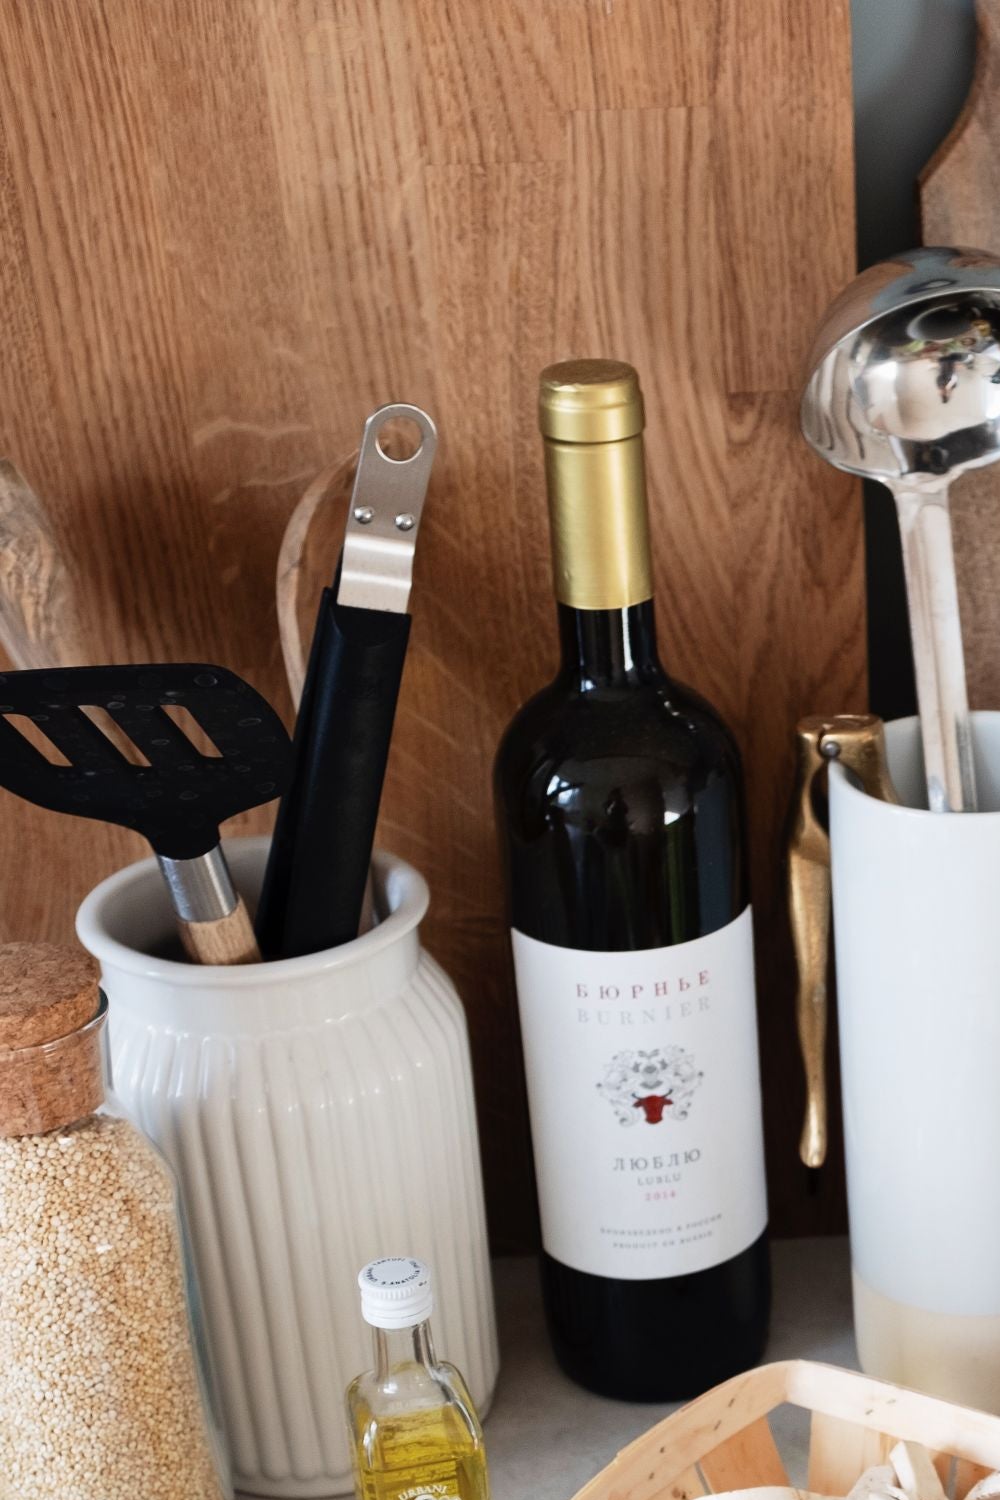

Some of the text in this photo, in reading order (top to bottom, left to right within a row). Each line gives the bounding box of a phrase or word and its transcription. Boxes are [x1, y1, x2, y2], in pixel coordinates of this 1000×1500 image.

[575, 969, 711, 1000] БЮРНЬЕ
[577, 996, 712, 1026] BURNIER
[613, 1148, 702, 1171] ЛЮБЛЮ
